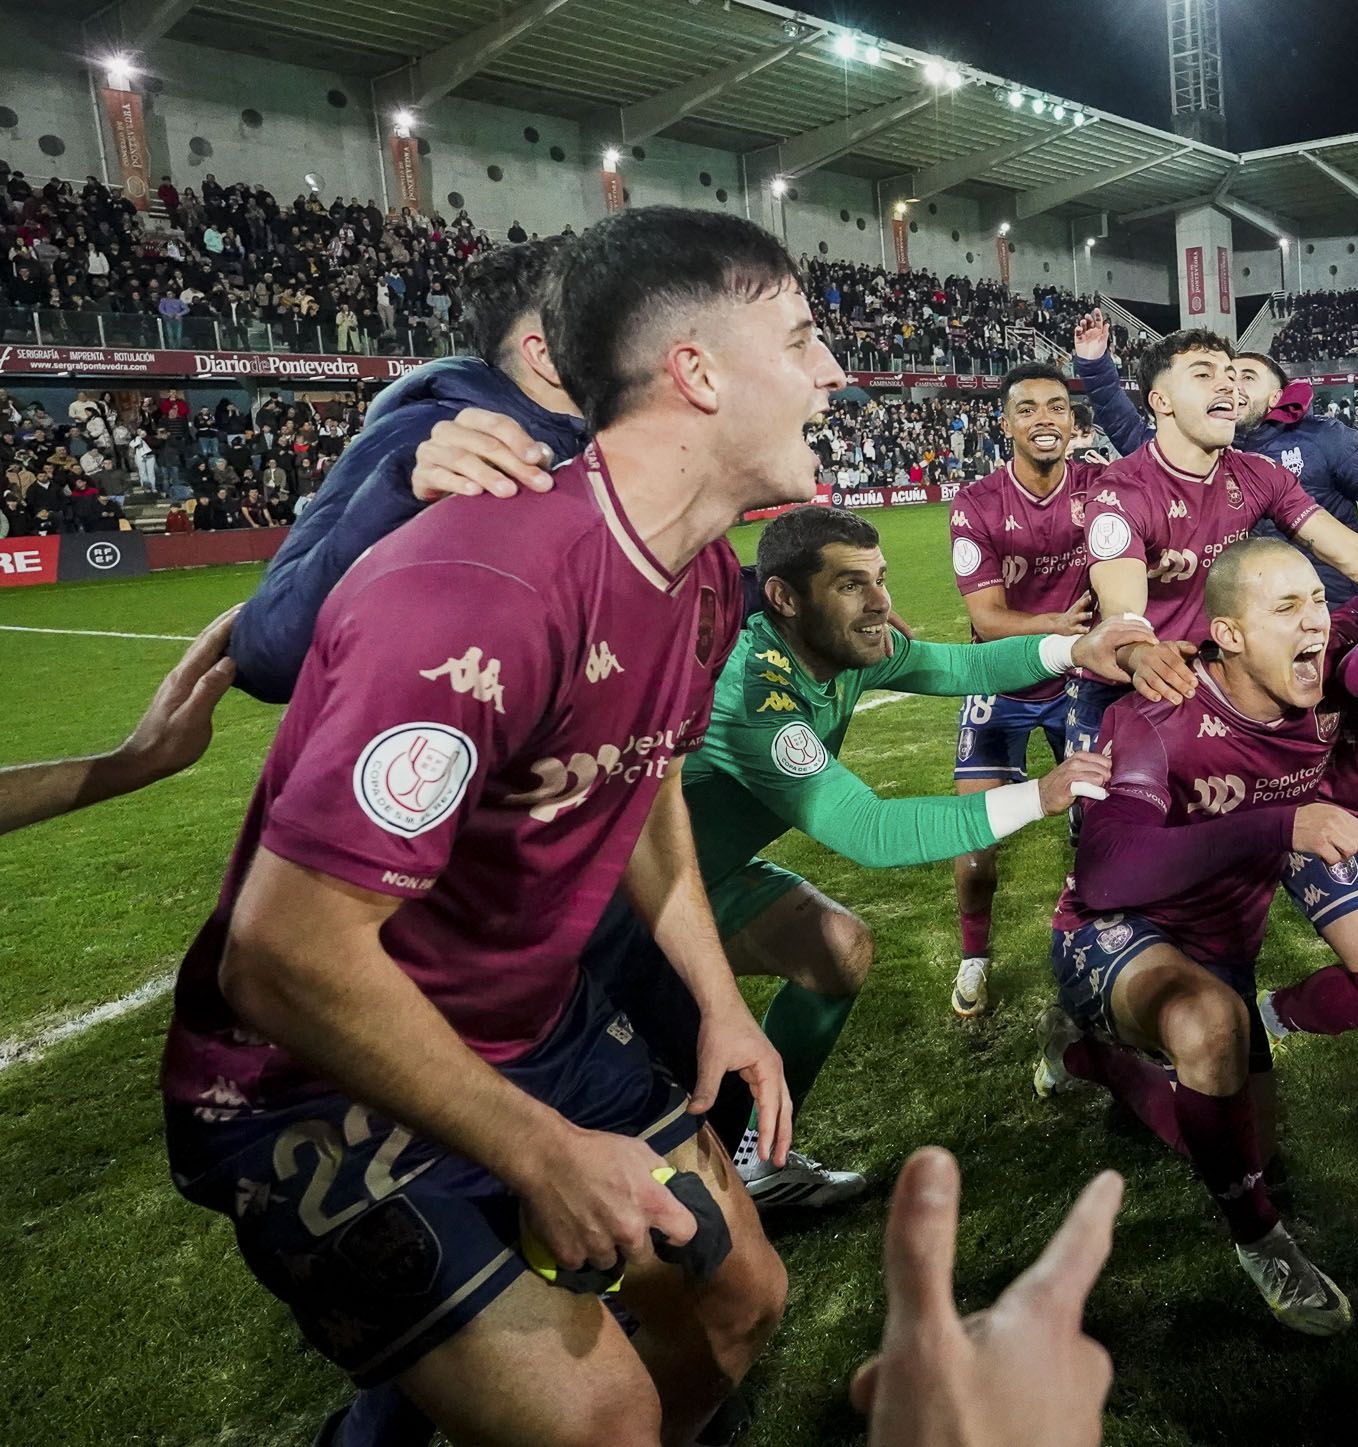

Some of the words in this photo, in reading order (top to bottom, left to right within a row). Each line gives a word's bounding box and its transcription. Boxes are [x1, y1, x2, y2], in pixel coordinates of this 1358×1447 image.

[17, 348, 60, 360] SERIGRAFÍA
[69, 351, 105, 361] IMPRENTA
[114, 351, 156, 363] ROTULACIÓN
[844, 491, 884, 506] ACUÑA
[891, 487, 928, 505] ACUÑA
[381, 870, 417, 889] NON
[273, 1104, 438, 1238] 22
